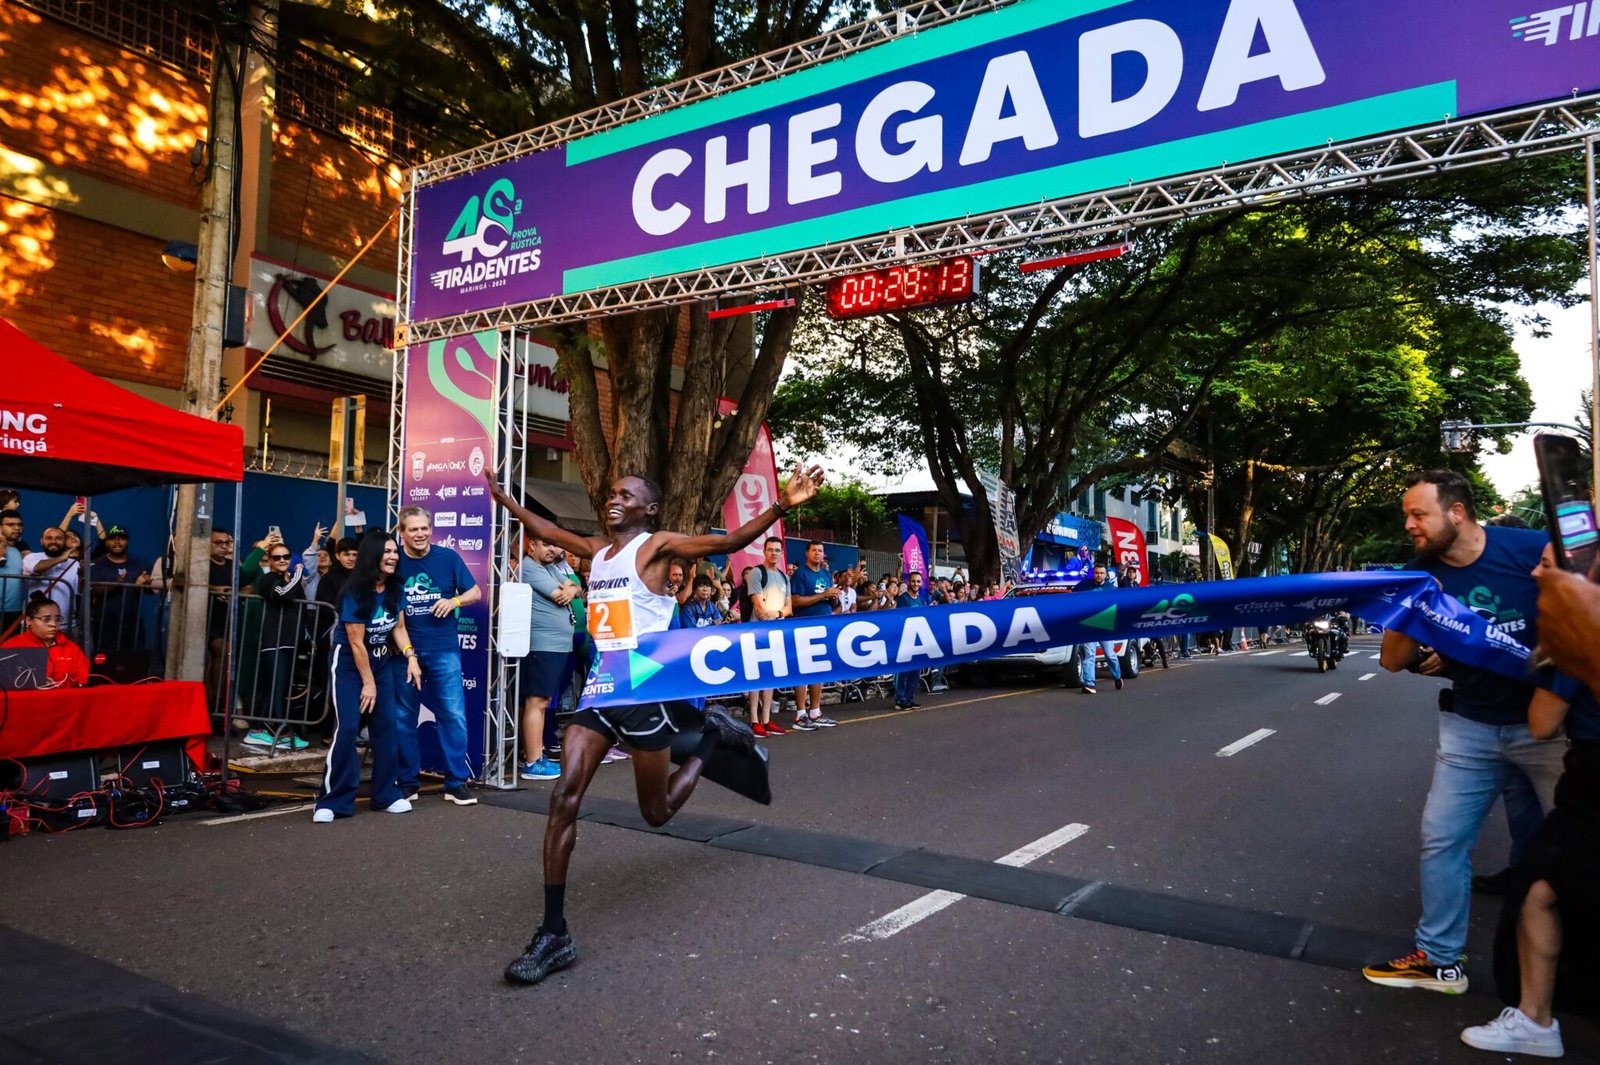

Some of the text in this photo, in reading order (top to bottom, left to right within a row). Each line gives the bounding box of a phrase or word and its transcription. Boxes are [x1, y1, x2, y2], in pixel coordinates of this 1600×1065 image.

[631, 0, 1326, 236] CHEGADA
[511, 227, 537, 240] PROVA
[430, 249, 541, 290] TIRADENTES
[841, 260, 968, 309] 00:28:13
[595, 603, 613, 632] 2
[1133, 615, 1209, 629] TIRADENTES
[1414, 600, 1470, 635] UNIFAMMA
[690, 606, 1050, 685] CHEGADA
